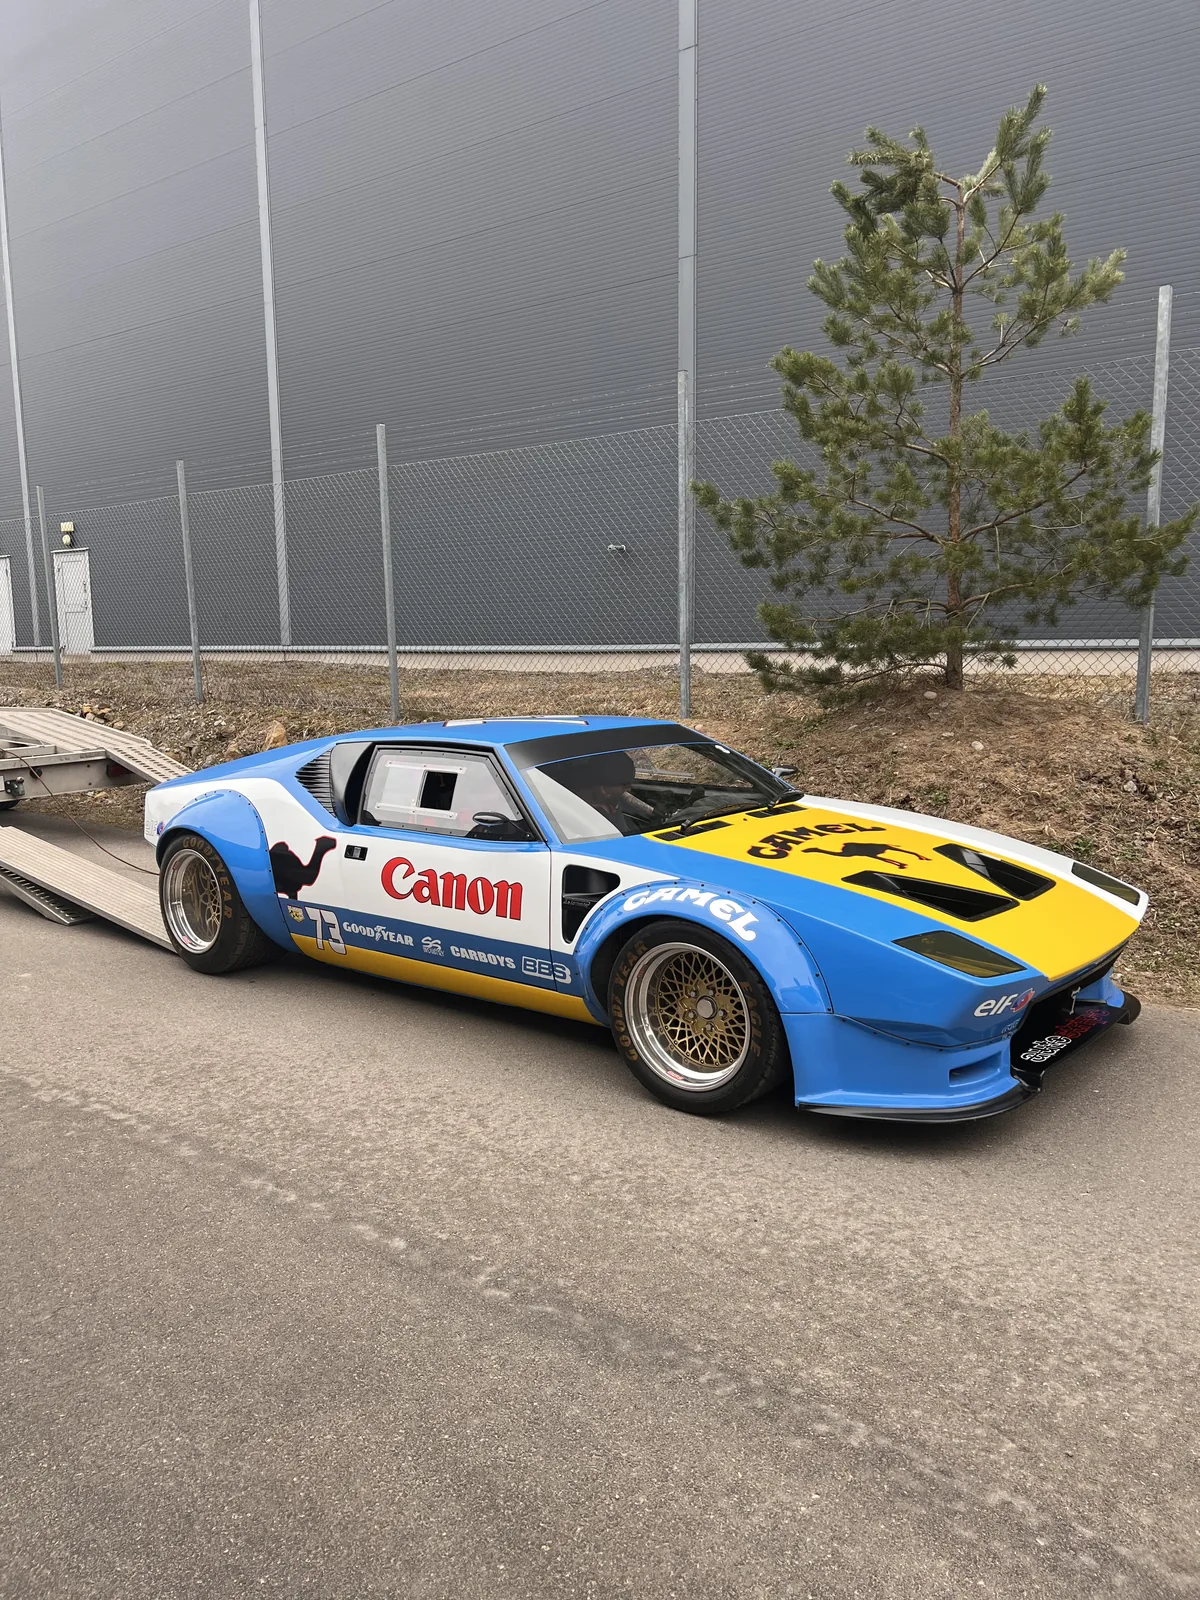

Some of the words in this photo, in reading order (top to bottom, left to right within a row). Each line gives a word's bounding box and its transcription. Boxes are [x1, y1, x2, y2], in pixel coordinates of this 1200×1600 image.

[746, 822, 887, 860] CAMEL
[380, 856, 523, 921] Canon
[304, 905, 347, 955] 73
[623, 887, 760, 942] CAMEL
[450, 946, 516, 969] CARBOYS
[521, 956, 571, 984] BBS
[974, 994, 1018, 1017] elf
